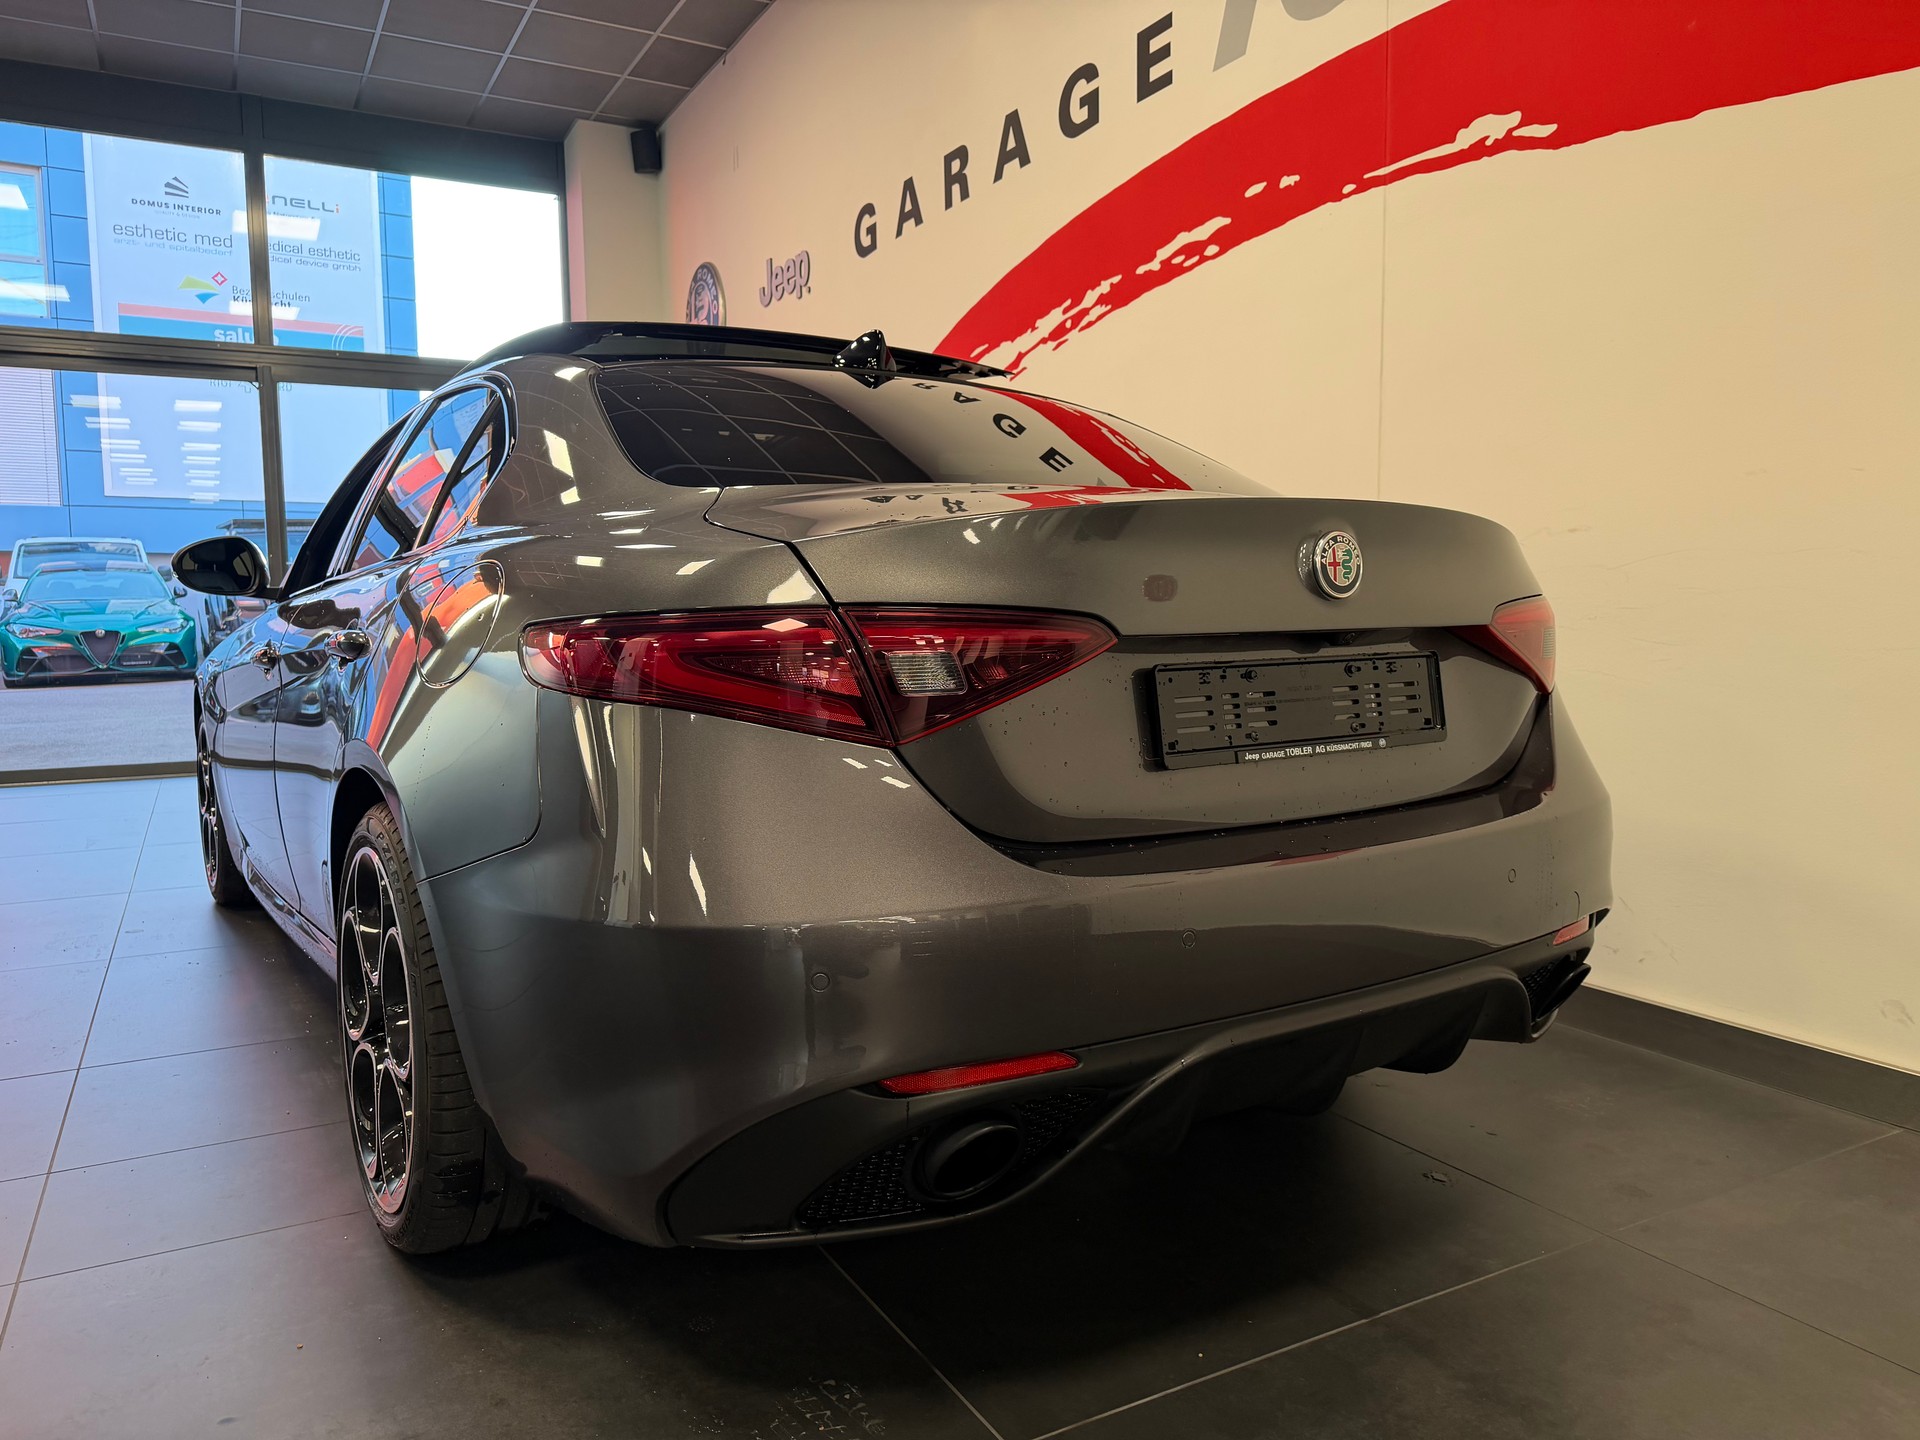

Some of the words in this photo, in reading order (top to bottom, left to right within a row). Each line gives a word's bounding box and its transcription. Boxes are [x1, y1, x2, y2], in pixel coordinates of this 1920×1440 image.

[853, 11, 1173, 259] GARAGE
[131, 198, 170, 209] DOMUS
[173, 203, 222, 215] INTERIOR
[113, 223, 187, 243] esthetic
[194, 233, 233, 249] med
[308, 246, 361, 261] esthetic
[295, 258, 329, 269] device
[332, 262, 361, 272] gmbh
[759, 251, 806, 308] Jeep
[1321, 539, 1335, 565] ALFA
[1336, 535, 1361, 565] ROMEO
[1244, 752, 1260, 761] Jeep
[1261, 750, 1286, 760] GARAGE
[1285, 745, 1313, 757] TOBLER
[1315, 744, 1326, 754] AG
